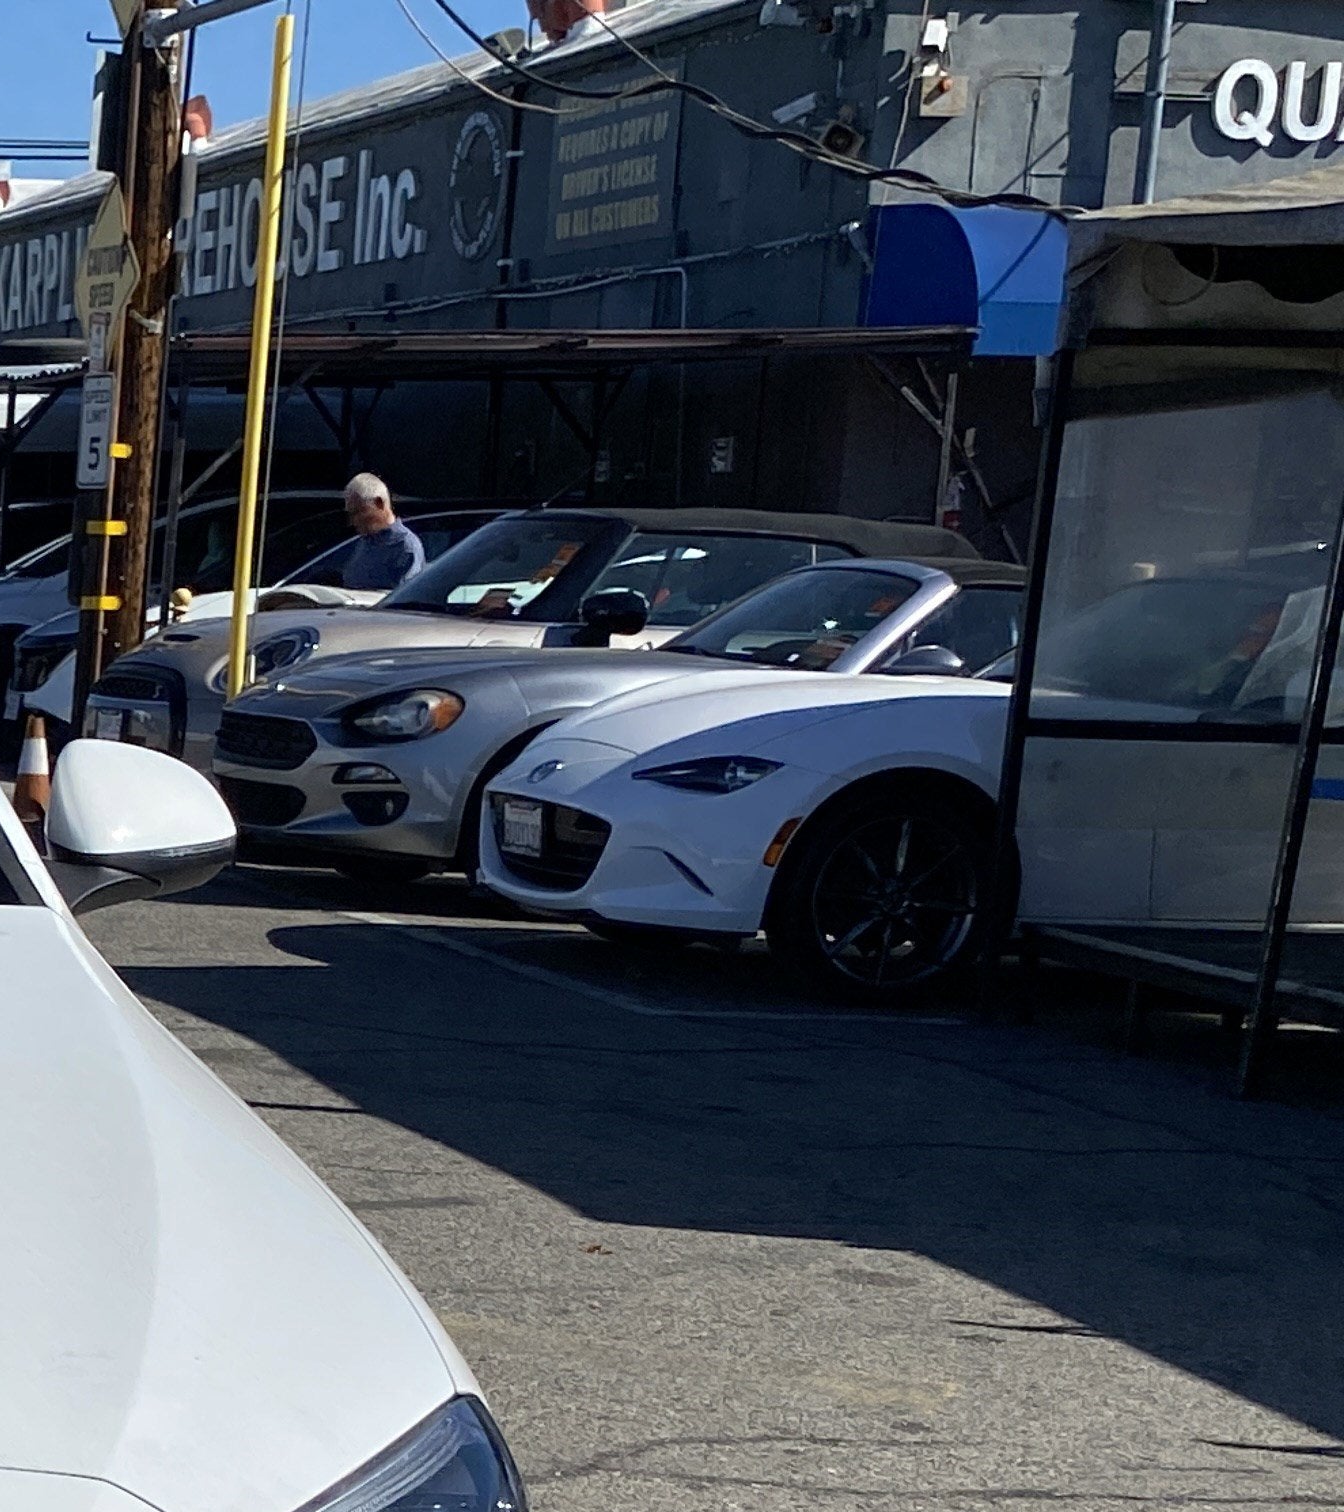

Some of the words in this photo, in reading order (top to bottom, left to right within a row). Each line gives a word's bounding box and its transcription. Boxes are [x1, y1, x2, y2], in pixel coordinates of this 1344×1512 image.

[1215, 58, 1344, 147] QU
[353, 149, 428, 266] Inc.
[88, 437, 100, 470] 5
